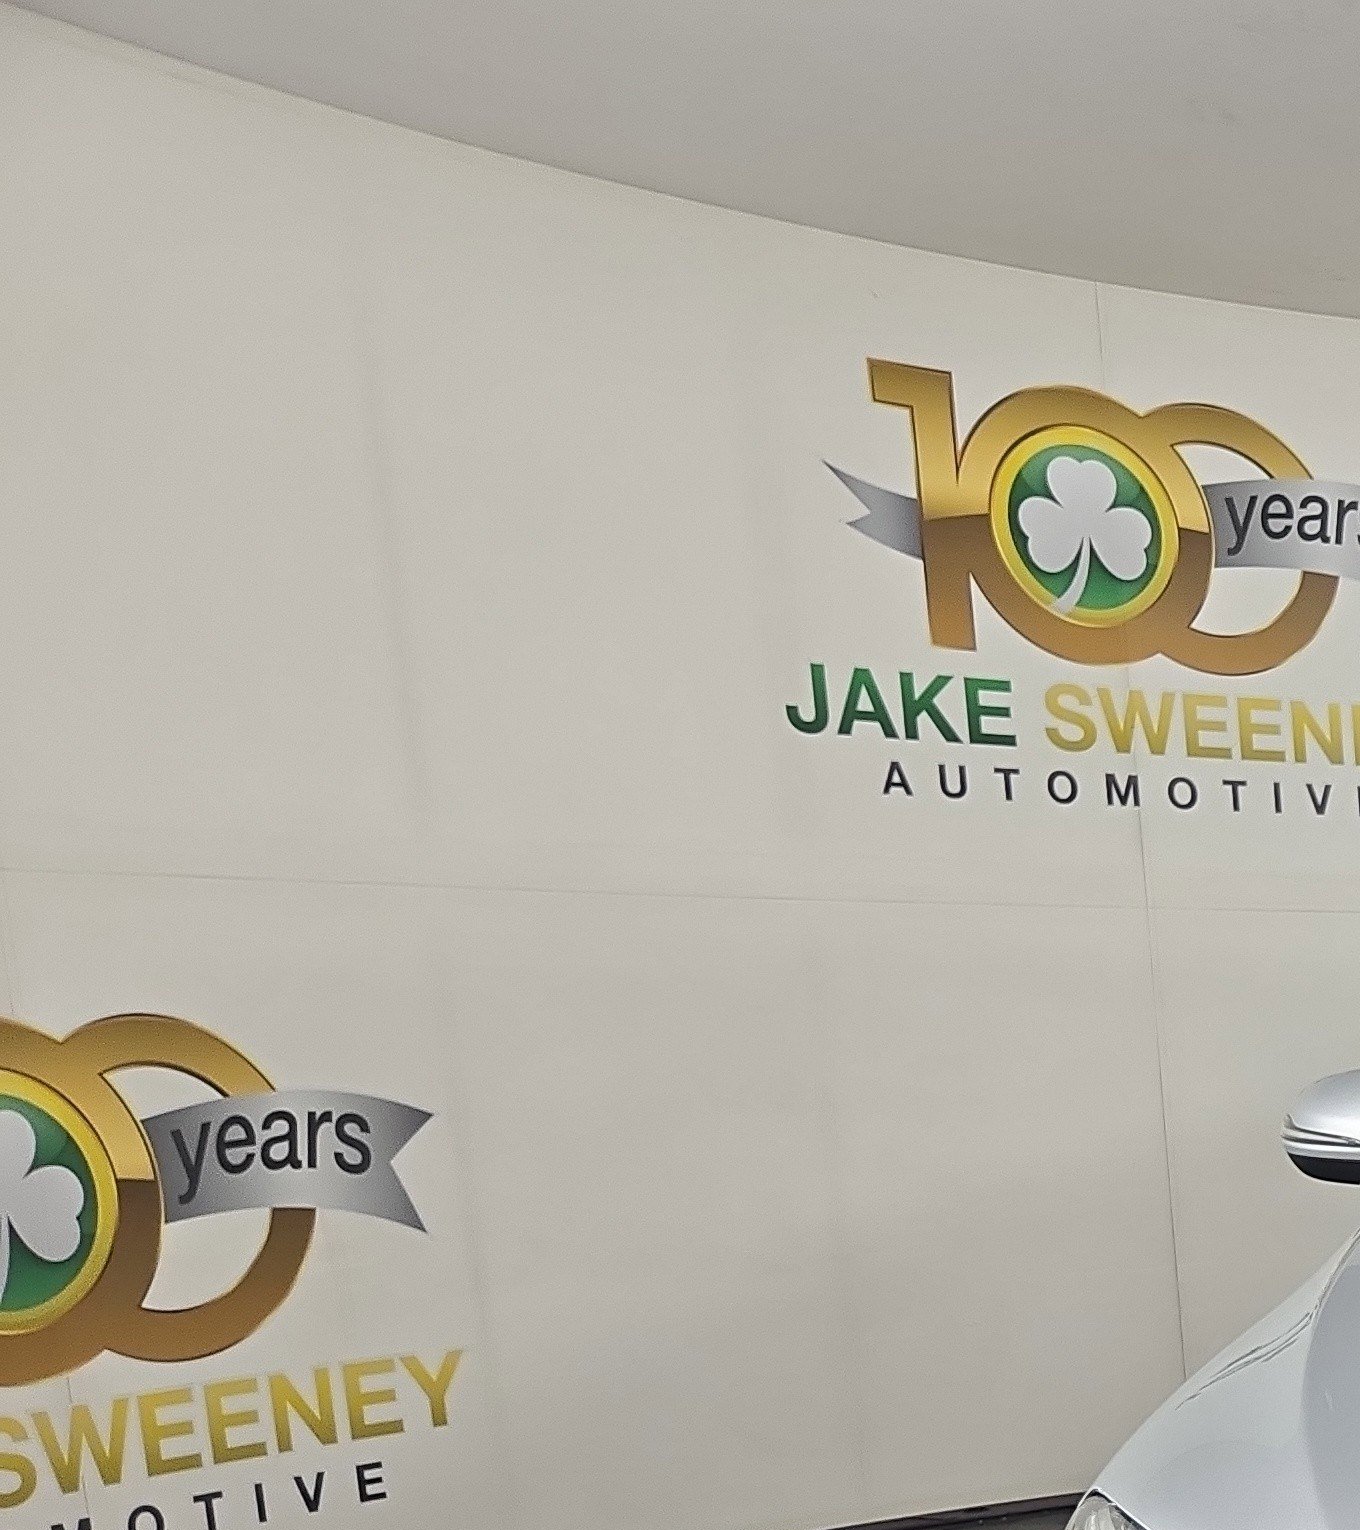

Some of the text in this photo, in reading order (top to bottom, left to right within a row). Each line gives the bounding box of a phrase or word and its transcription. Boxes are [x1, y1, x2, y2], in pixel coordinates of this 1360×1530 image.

[867, 358, 1340, 676] 100
[786, 663, 1017, 746] JAKE
[170, 1109, 371, 1201] years
[0, 1349, 463, 1509] SWEENEY
